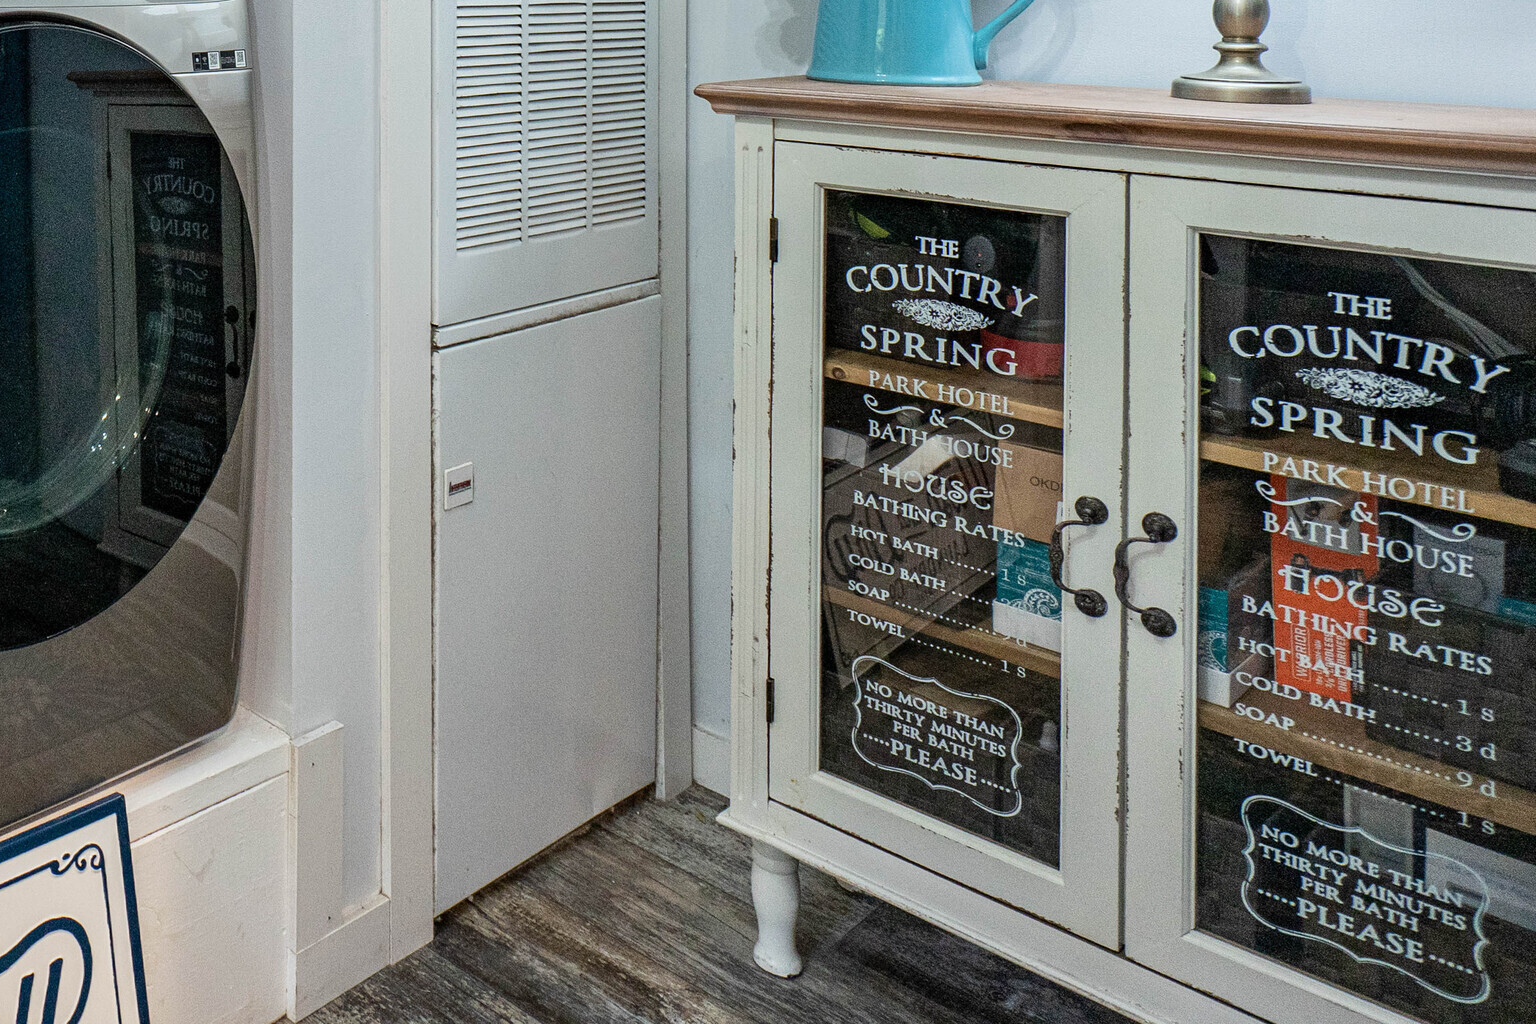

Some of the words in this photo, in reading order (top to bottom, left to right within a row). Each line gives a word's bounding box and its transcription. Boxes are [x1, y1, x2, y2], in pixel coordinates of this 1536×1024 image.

[915, 235, 959, 259] THE
[845, 263, 1038, 318] COUNTRY
[1327, 291, 1392, 320] THE
[860, 324, 1018, 376] SPRING
[1228, 324, 1511, 394] COUNTRY
[868, 370, 930, 400] PARK
[937, 383, 1015, 416] HOTEL
[929, 409, 948, 428] &
[868, 419, 927, 448] BATH
[937, 433, 1013, 469] HOUSE
[1250, 397, 1481, 465] SPRING
[1263, 451, 1351, 489] PARK
[1362, 470, 1476, 514] HOTEL
[853, 490, 948, 528] BATHING
[955, 515, 1026, 549] RATES
[1350, 501, 1378, 525] &
[850, 524, 887, 545] HOT
[893, 536, 938, 560] BATH
[1263, 510, 1349, 551] BATH
[1361, 532, 1474, 578] HOUSE
[848, 553, 895, 576] COLD
[900, 567, 947, 592] BATH
[848, 579, 890, 601] SOAP
[846, 609, 906, 638] TOWEL
[1241, 594, 1378, 647] BATHING
[1388, 631, 1493, 676] RATES
[1238, 636, 1292, 663] HOT
[1297, 651, 1365, 686] BATH
[864, 695, 925, 726] THIRTY
[931, 720, 1006, 757] MINUTES
[866, 680, 892, 698] NO
[897, 691, 947, 719] MORE
[954, 710, 1005, 739] THAN
[1235, 671, 1302, 701] COLD
[1309, 691, 1377, 723] BATH
[1455, 735, 1472, 753] 3
[1480, 743, 1497, 762] d
[890, 738, 978, 787] PLEASE
[893, 720, 923, 742] PER
[928, 734, 974, 761] BATH
[1234, 738, 1318, 778] TOWEL
[1235, 702, 1296, 732] SOAP
[1455, 772, 1473, 788] 9
[1480, 781, 1497, 799] d
[1258, 843, 1348, 887] THIRTY
[1354, 879, 1467, 931] MINUTES
[1261, 824, 1299, 849] NO
[1305, 840, 1380, 879] MORE
[1387, 868, 1464, 908] THAN
[1296, 897, 1425, 964] PLEASE
[1300, 876, 1344, 905] PER
[1351, 894, 1420, 933] BATH
